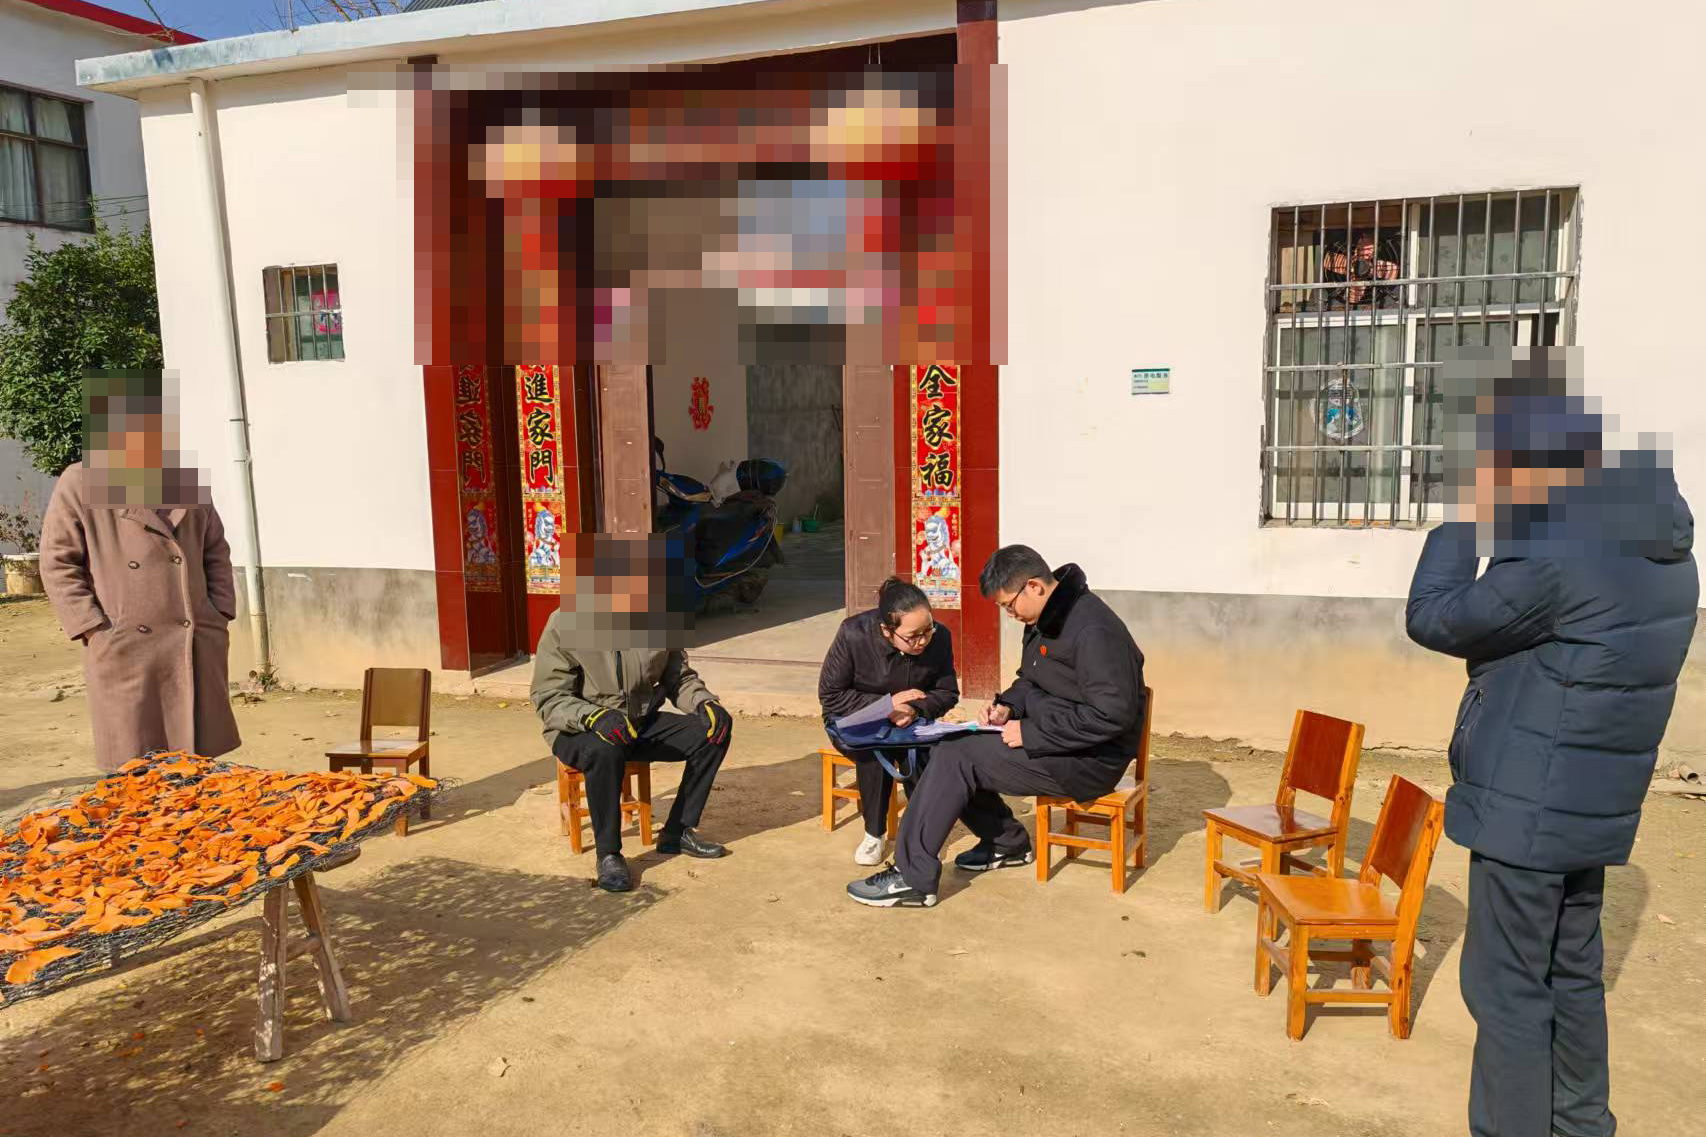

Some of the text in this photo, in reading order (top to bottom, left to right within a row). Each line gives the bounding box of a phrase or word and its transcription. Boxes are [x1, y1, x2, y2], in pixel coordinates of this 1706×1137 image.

[525, 365, 553, 484] 進家門
[919, 365, 956, 488] 全家福
